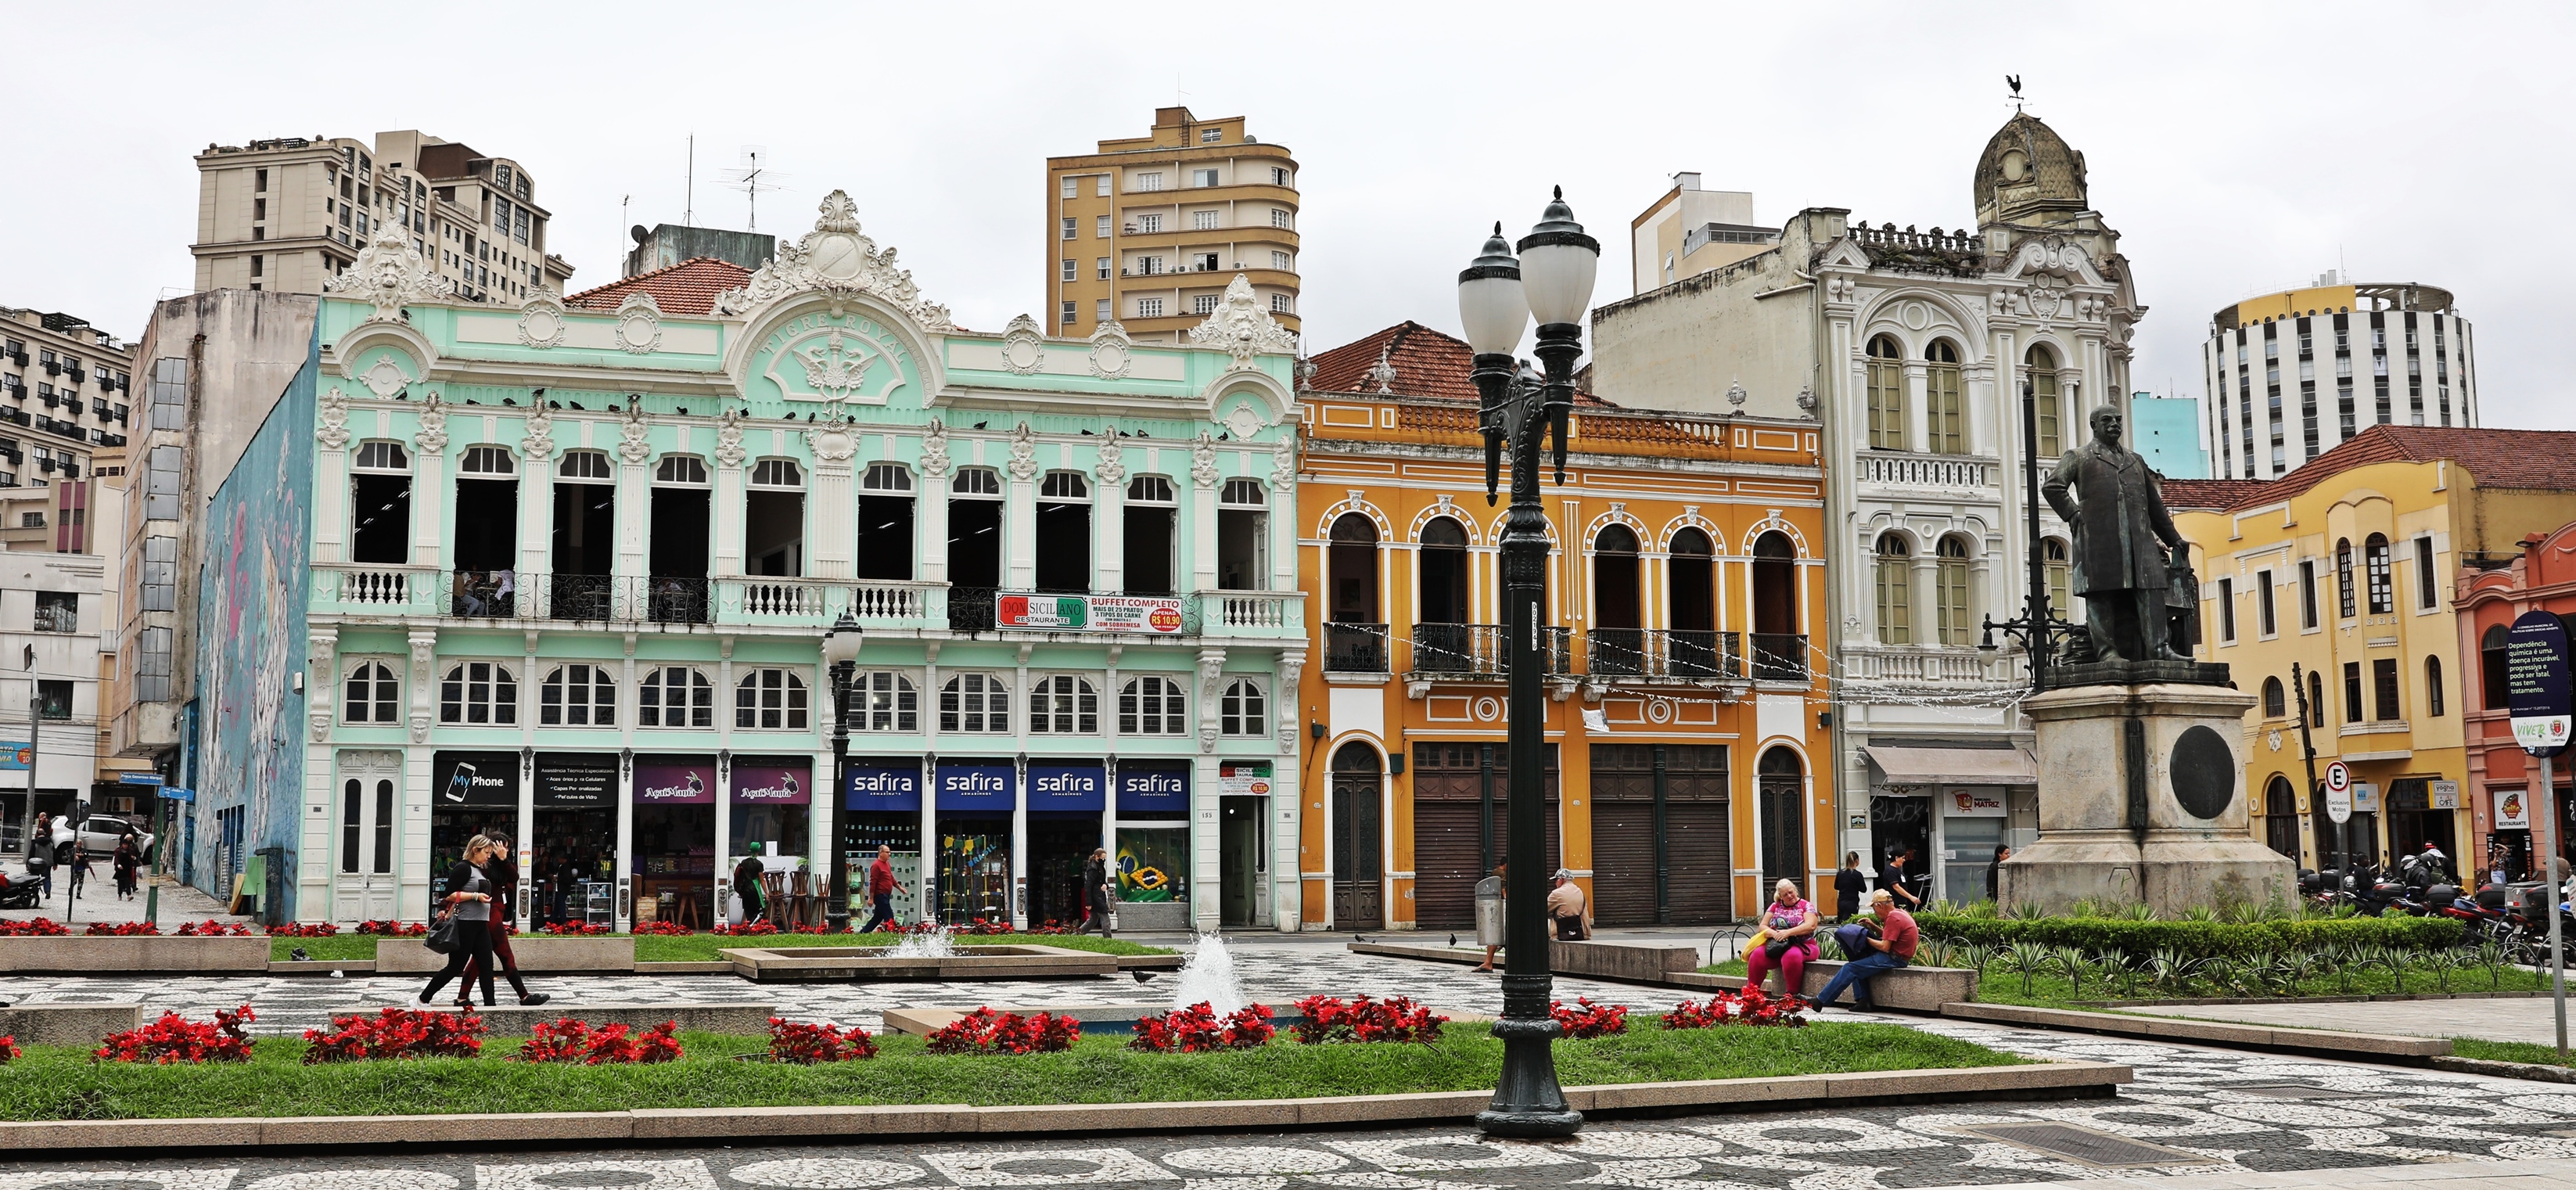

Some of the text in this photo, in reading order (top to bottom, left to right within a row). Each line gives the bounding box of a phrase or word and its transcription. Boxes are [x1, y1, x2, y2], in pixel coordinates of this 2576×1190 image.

[760, 313, 907, 364] TIGRE ROYAL
[1004, 602, 1081, 615] DON SICILIANO
[1128, 599, 1179, 608] COMPLETO
[1151, 616, 1180, 625] R$ 10,90
[2509, 640, 2547, 649] Dependência
[2510, 663, 2542, 672] progressiva
[454, 775, 504, 788] My Phone
[853, 772, 912, 791] safira
[946, 772, 1003, 791] safira
[1037, 773, 1094, 791] safira
[1126, 775, 1181, 792] safira
[2333, 769, 2342, 785] E
[1872, 797, 1924, 823] BLACK
[968, 844, 997, 867] BRASIL
